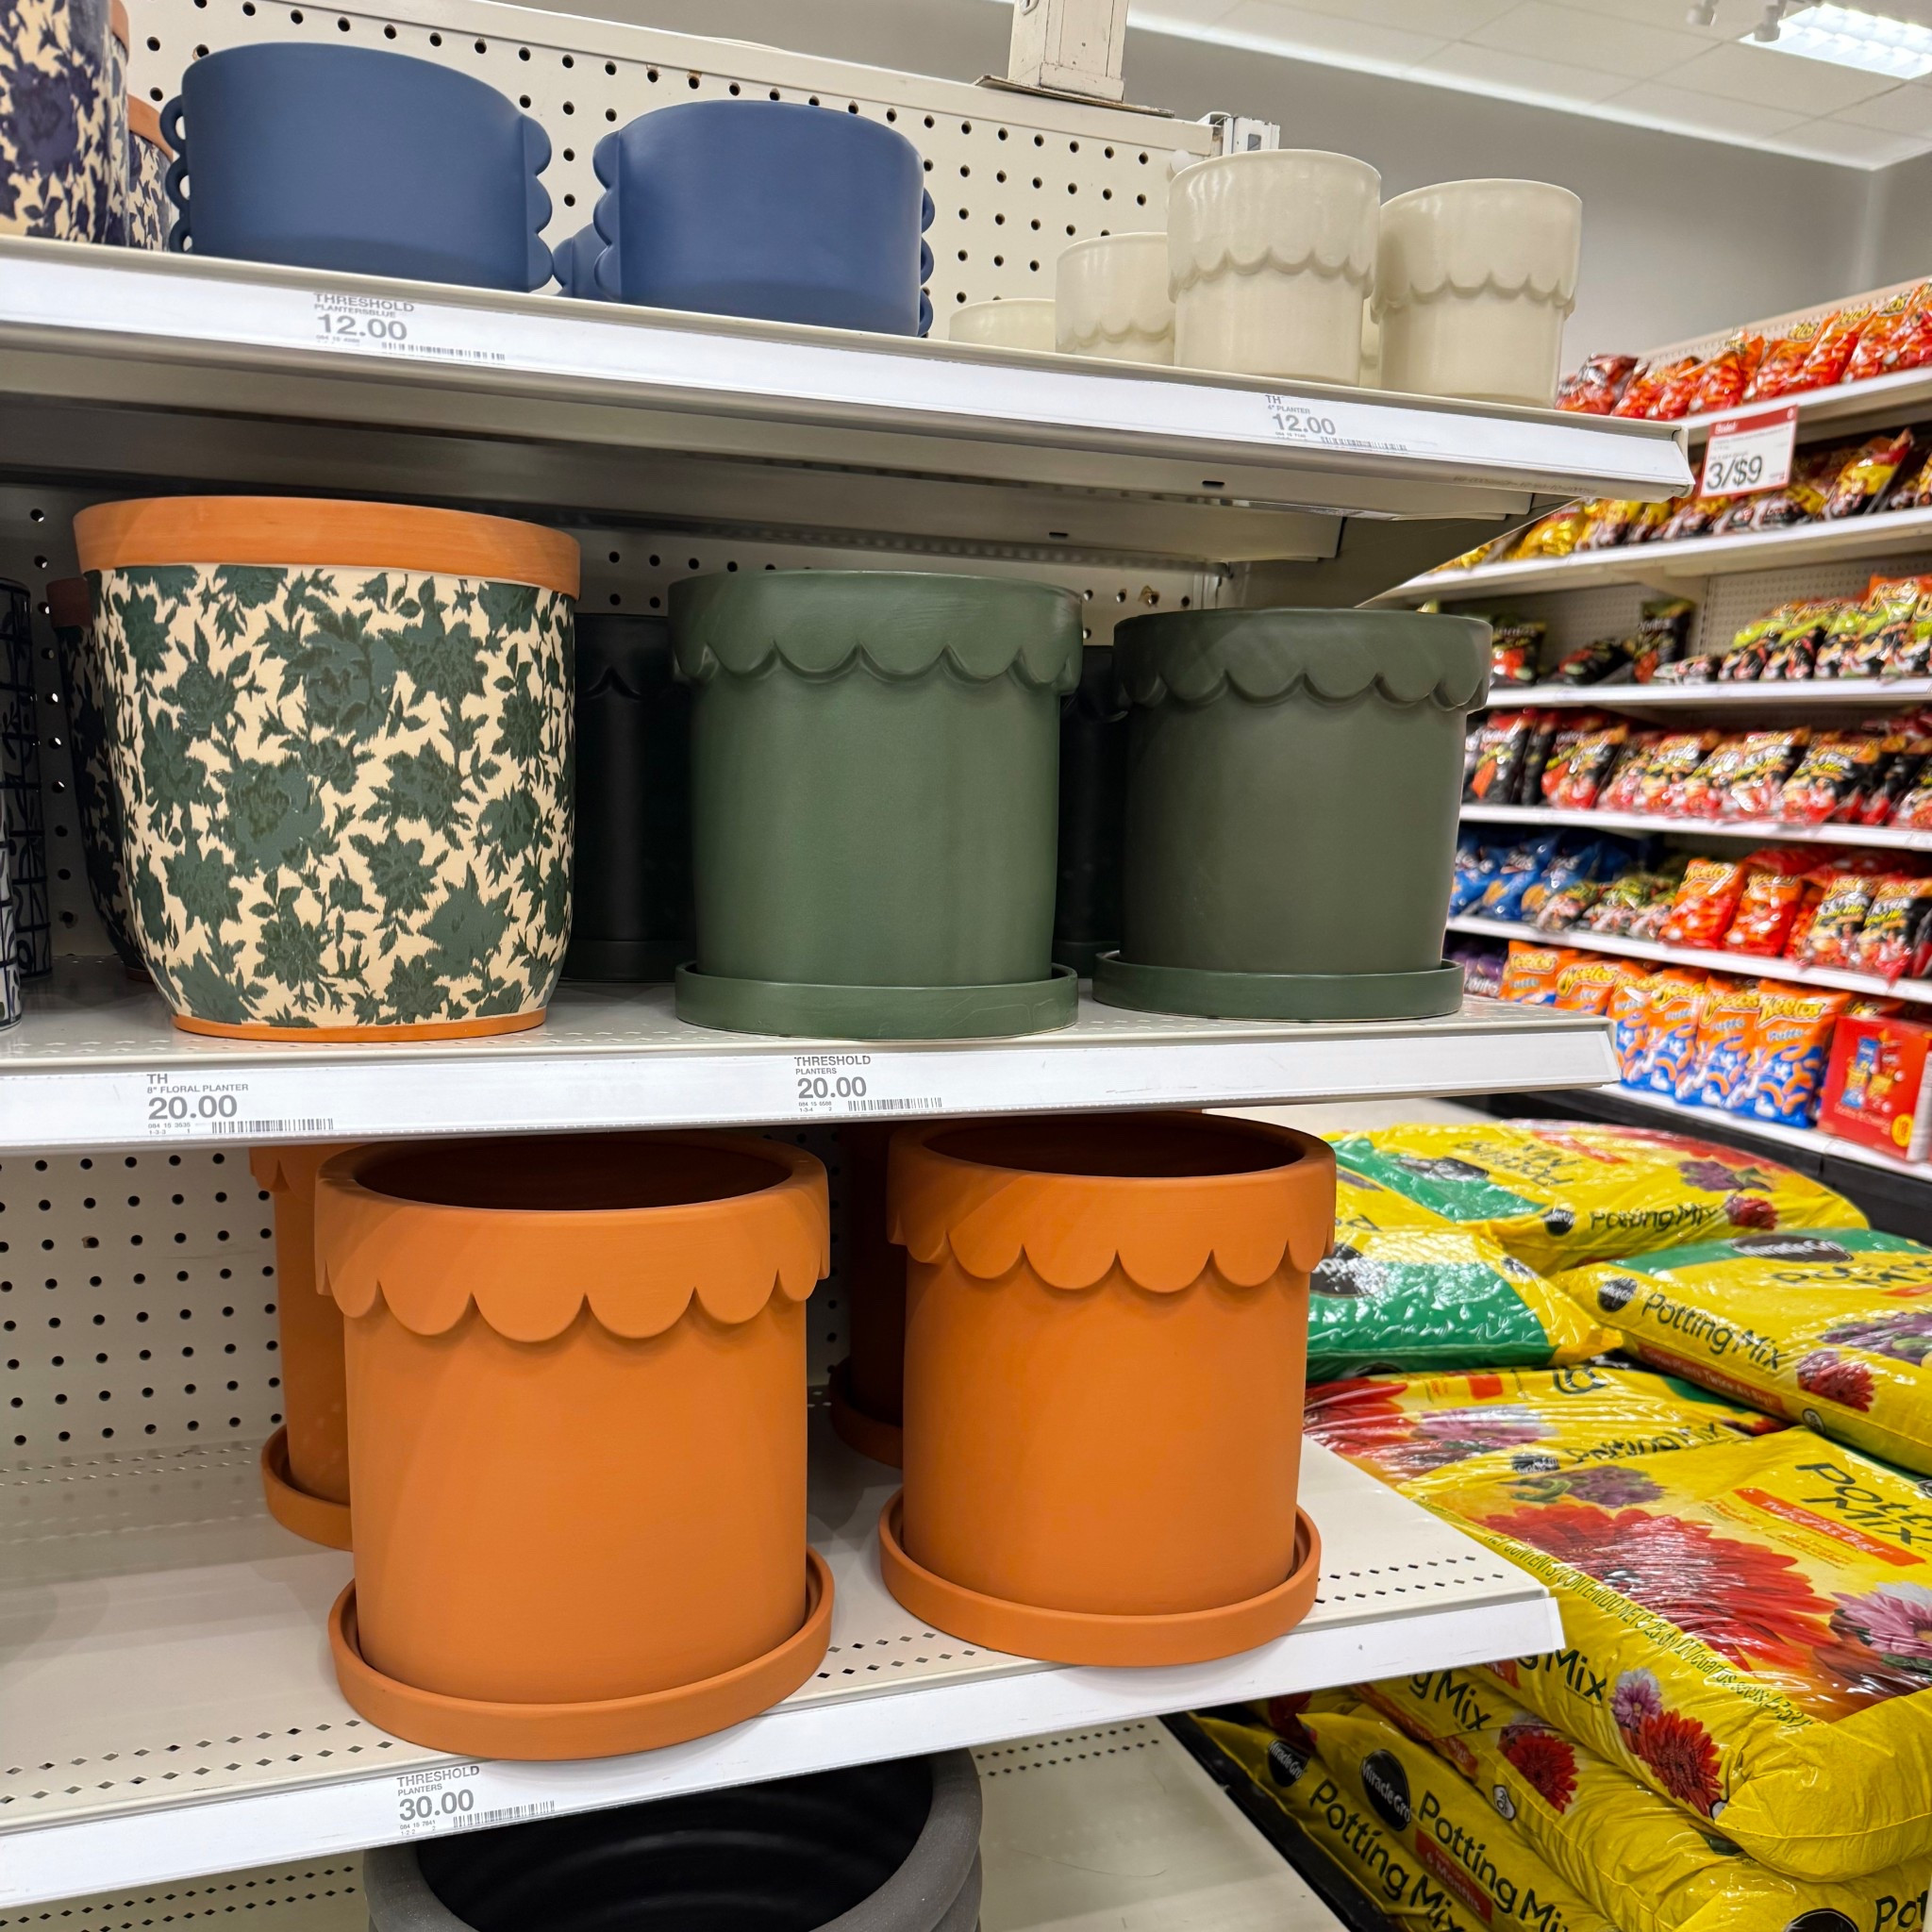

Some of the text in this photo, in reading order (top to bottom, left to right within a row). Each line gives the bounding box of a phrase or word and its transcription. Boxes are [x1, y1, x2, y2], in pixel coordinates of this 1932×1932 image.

[314, 293, 415, 312] THRESHOLD
[314, 304, 396, 318] PLANTERSBLUE
[317, 313, 408, 341] 12.00
[1265, 394, 1282, 405] TH
[1276, 406, 1310, 414] PLANTER
[1273, 413, 1336, 436] 12.00
[1706, 455, 1762, 490] 3/$9
[794, 1056, 871, 1067] THRESHOLD
[146, 1073, 168, 1085] TH
[160, 1085, 201, 1094] FLORAL
[203, 1084, 249, 1092] PLANTER
[797, 1076, 867, 1099] 20.00
[148, 1094, 238, 1121] 20.00
[1641, 1292, 1733, 1356] Potting
[1732, 1328, 1789, 1371] Mix
[1801, 1497, 1932, 1546] Mix
[1545, 1649, 1607, 1702] Mix
[1434, 1671, 1491, 1730] Mix
[396, 1765, 480, 1787] THRESHOLD
[397, 1783, 442, 1796] PLANTERS
[399, 1789, 475, 1822] 30.00
[1310, 1780, 1465, 1932] Potting Mix
[1418, 1791, 1568, 1932] Potting Mi
